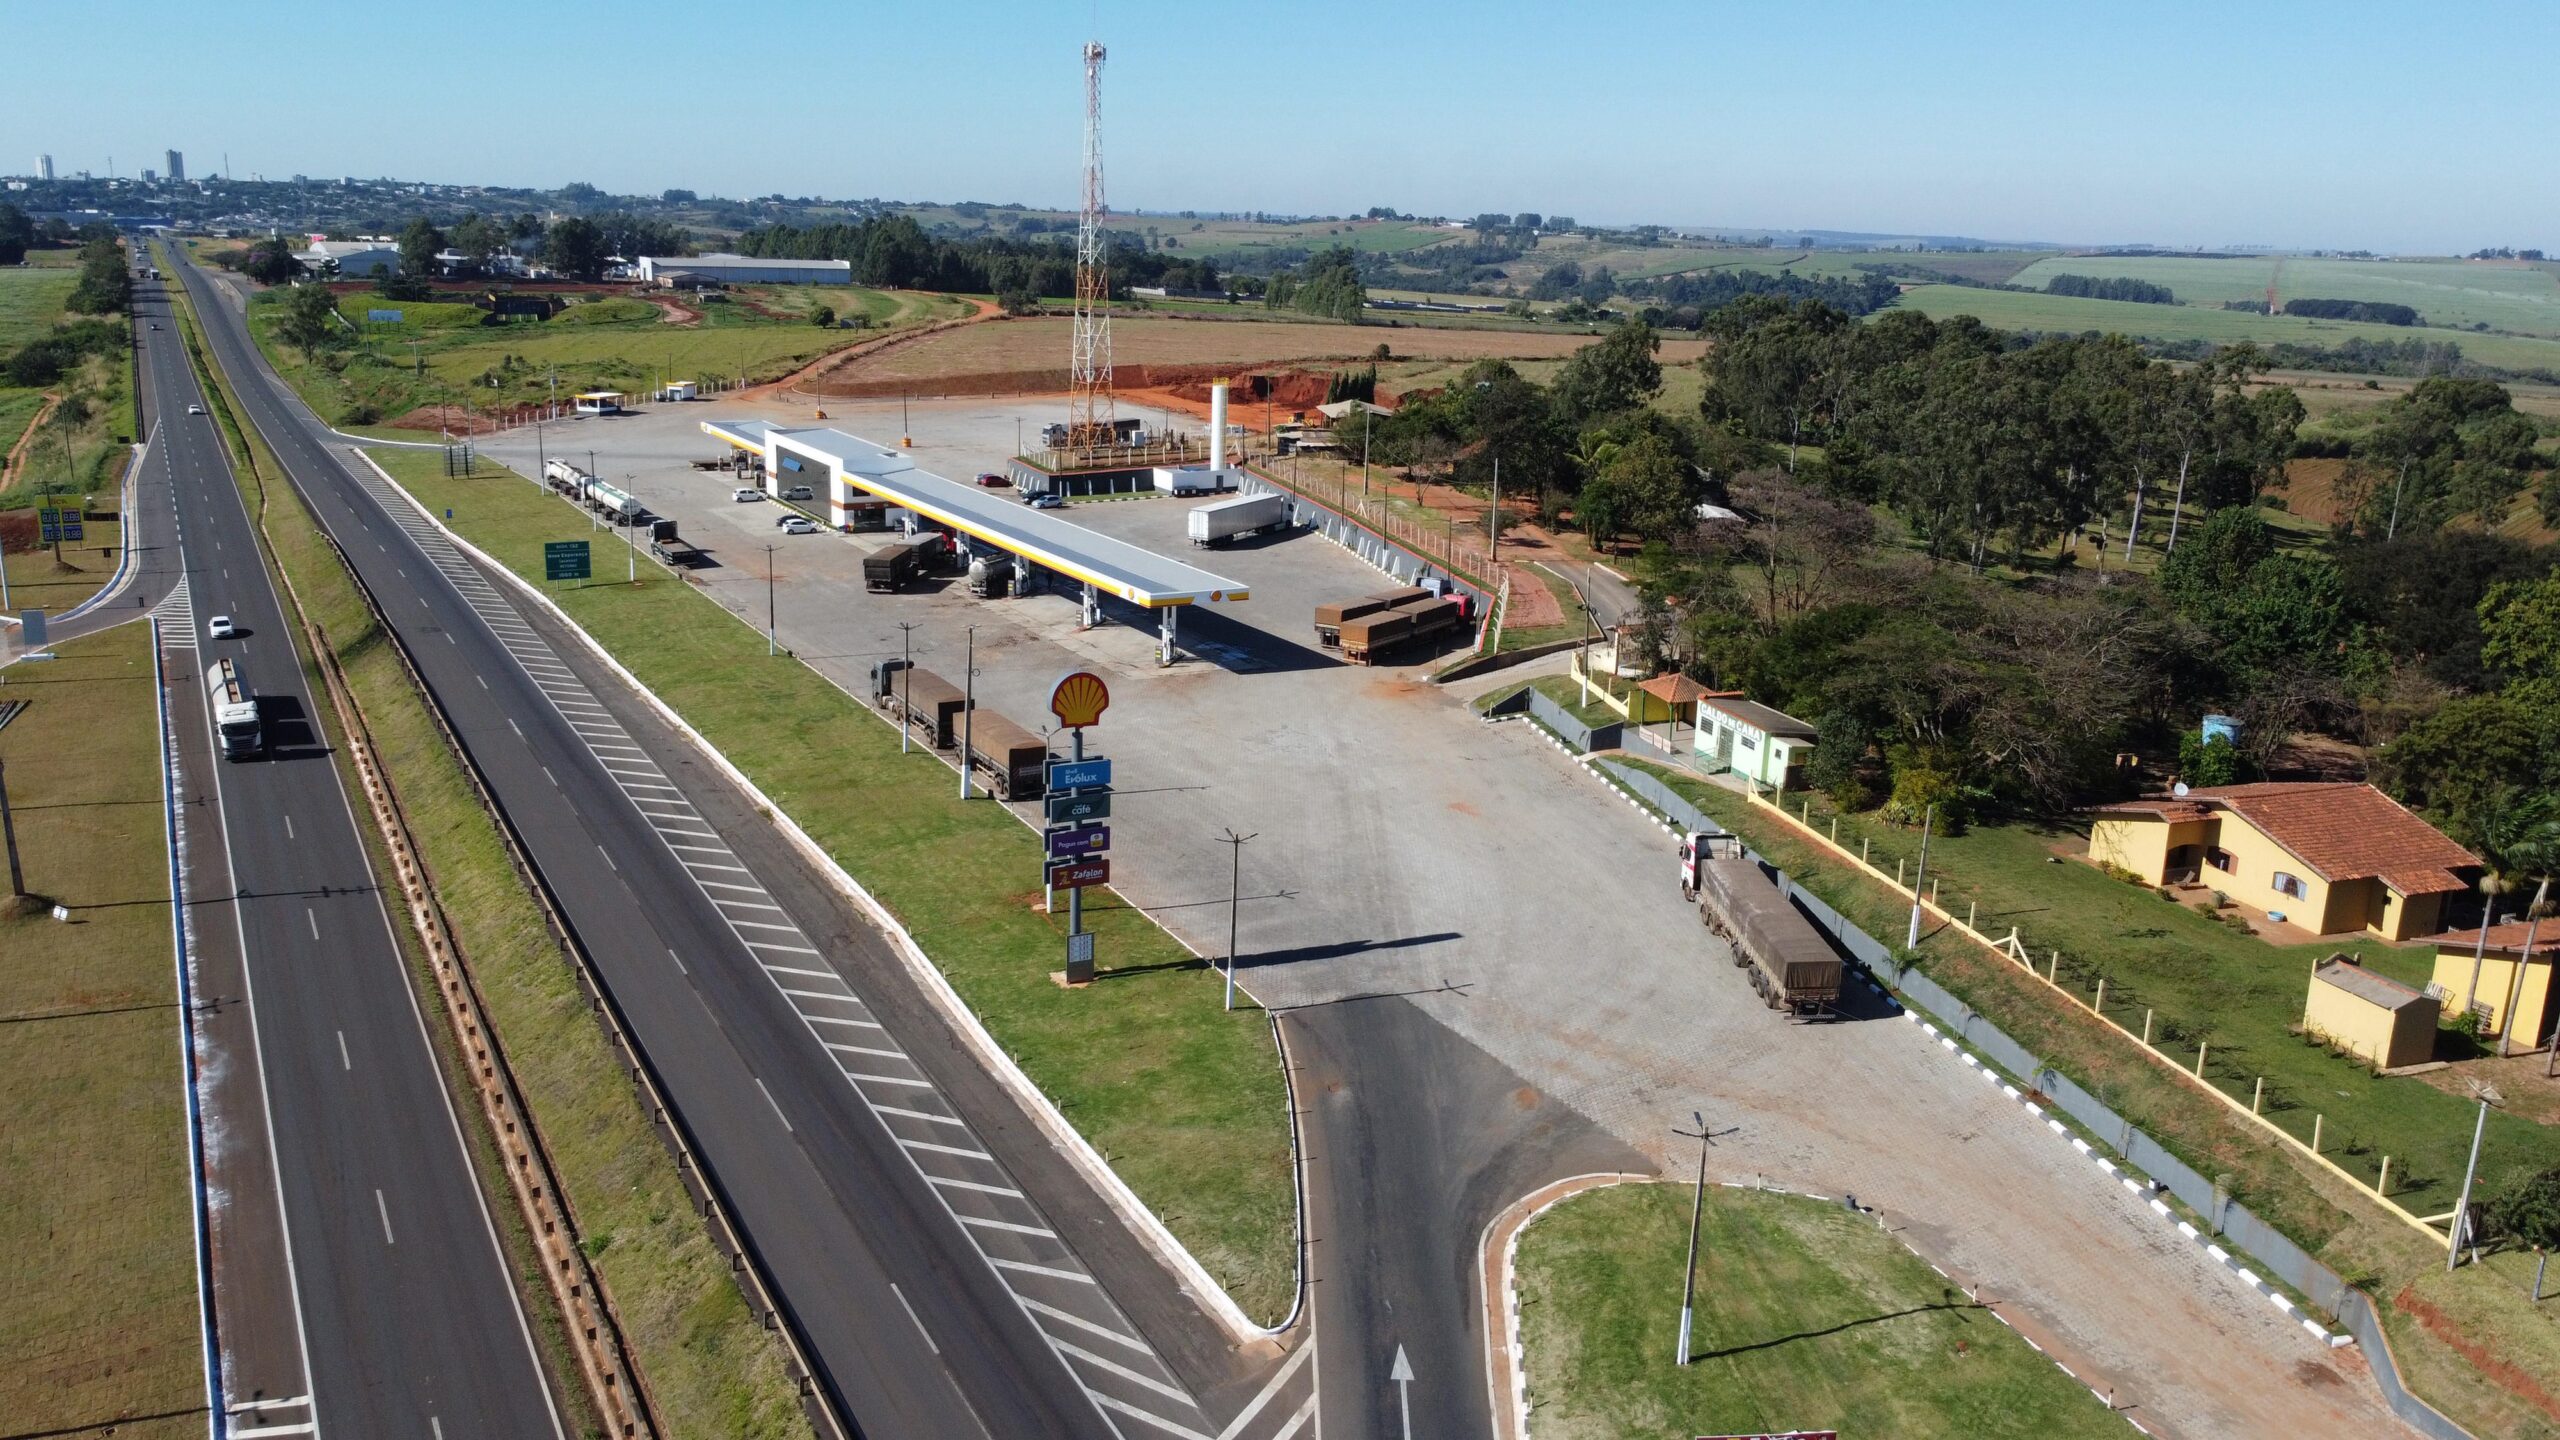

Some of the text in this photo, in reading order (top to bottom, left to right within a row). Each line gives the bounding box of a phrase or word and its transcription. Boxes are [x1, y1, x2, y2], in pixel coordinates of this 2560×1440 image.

[1701, 702, 1728, 725] CALDO
[1736, 720, 1762, 741] CANA
[1072, 868, 1103, 880] Zafalon
